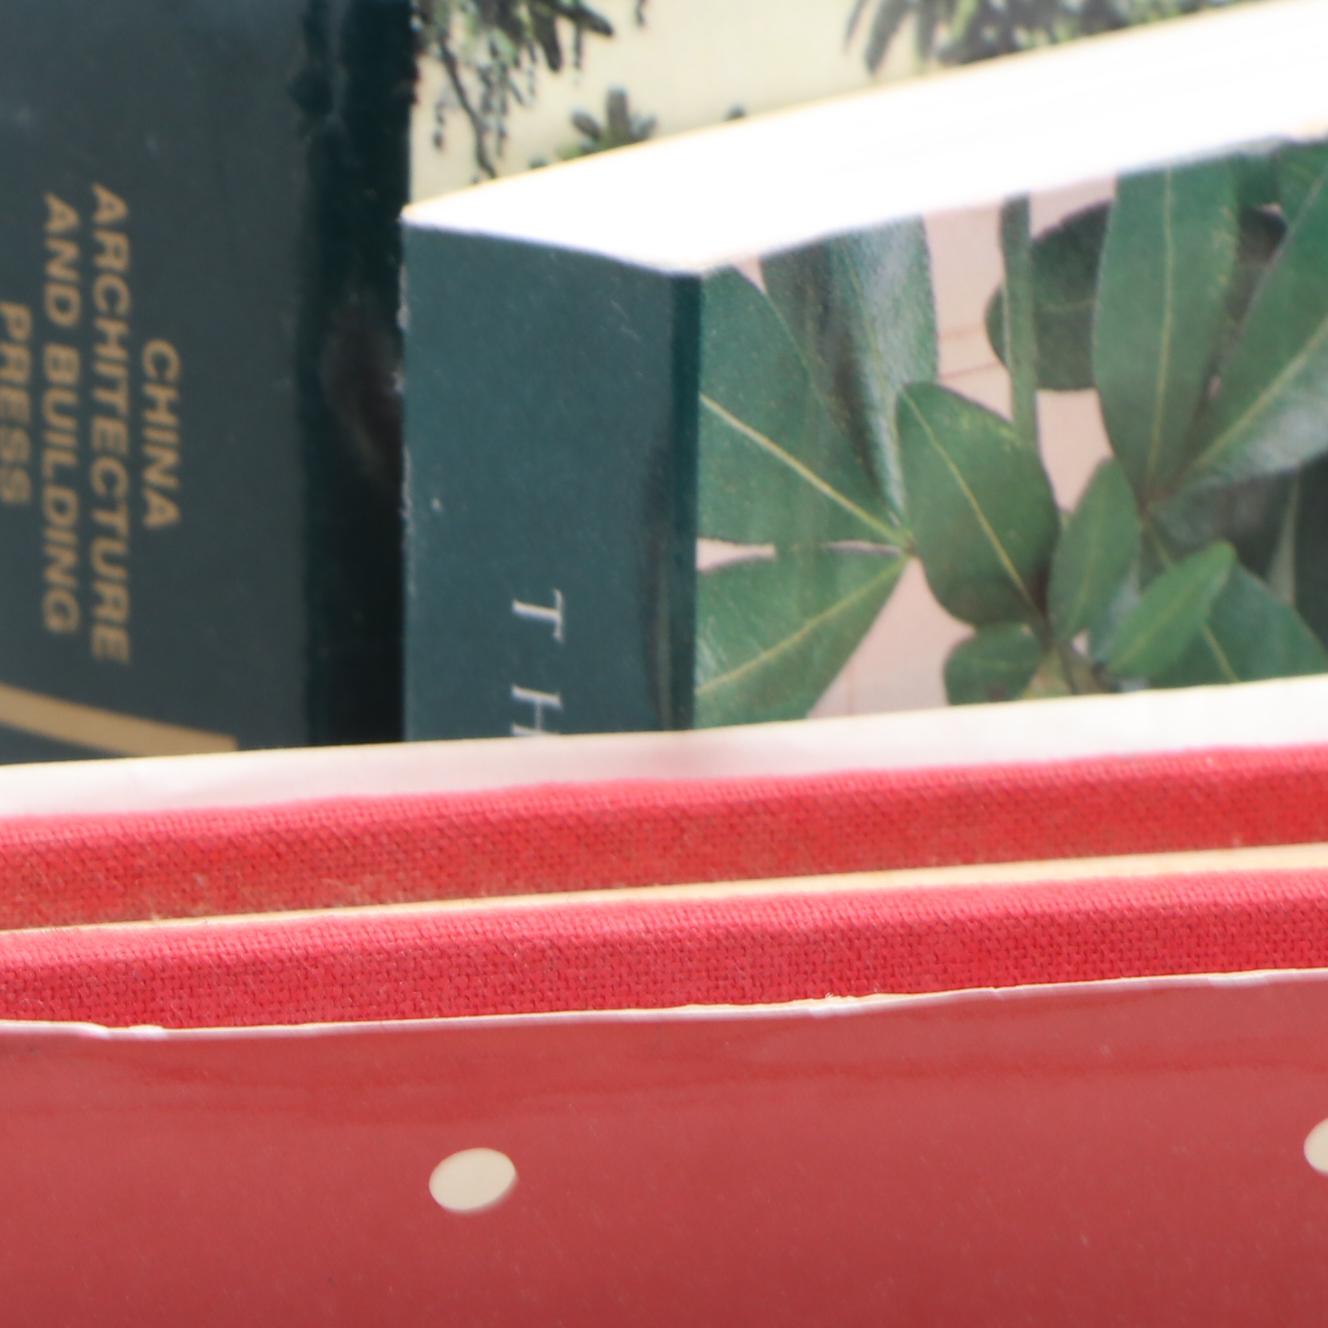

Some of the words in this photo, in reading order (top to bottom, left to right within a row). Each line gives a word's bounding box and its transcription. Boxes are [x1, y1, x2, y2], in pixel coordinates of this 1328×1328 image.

[43, 192, 81, 328] AND
[42, 343, 81, 634] BUILDING
[91, 182, 131, 664] ARCHITECTURE
[142, 339, 181, 529] CHINA
